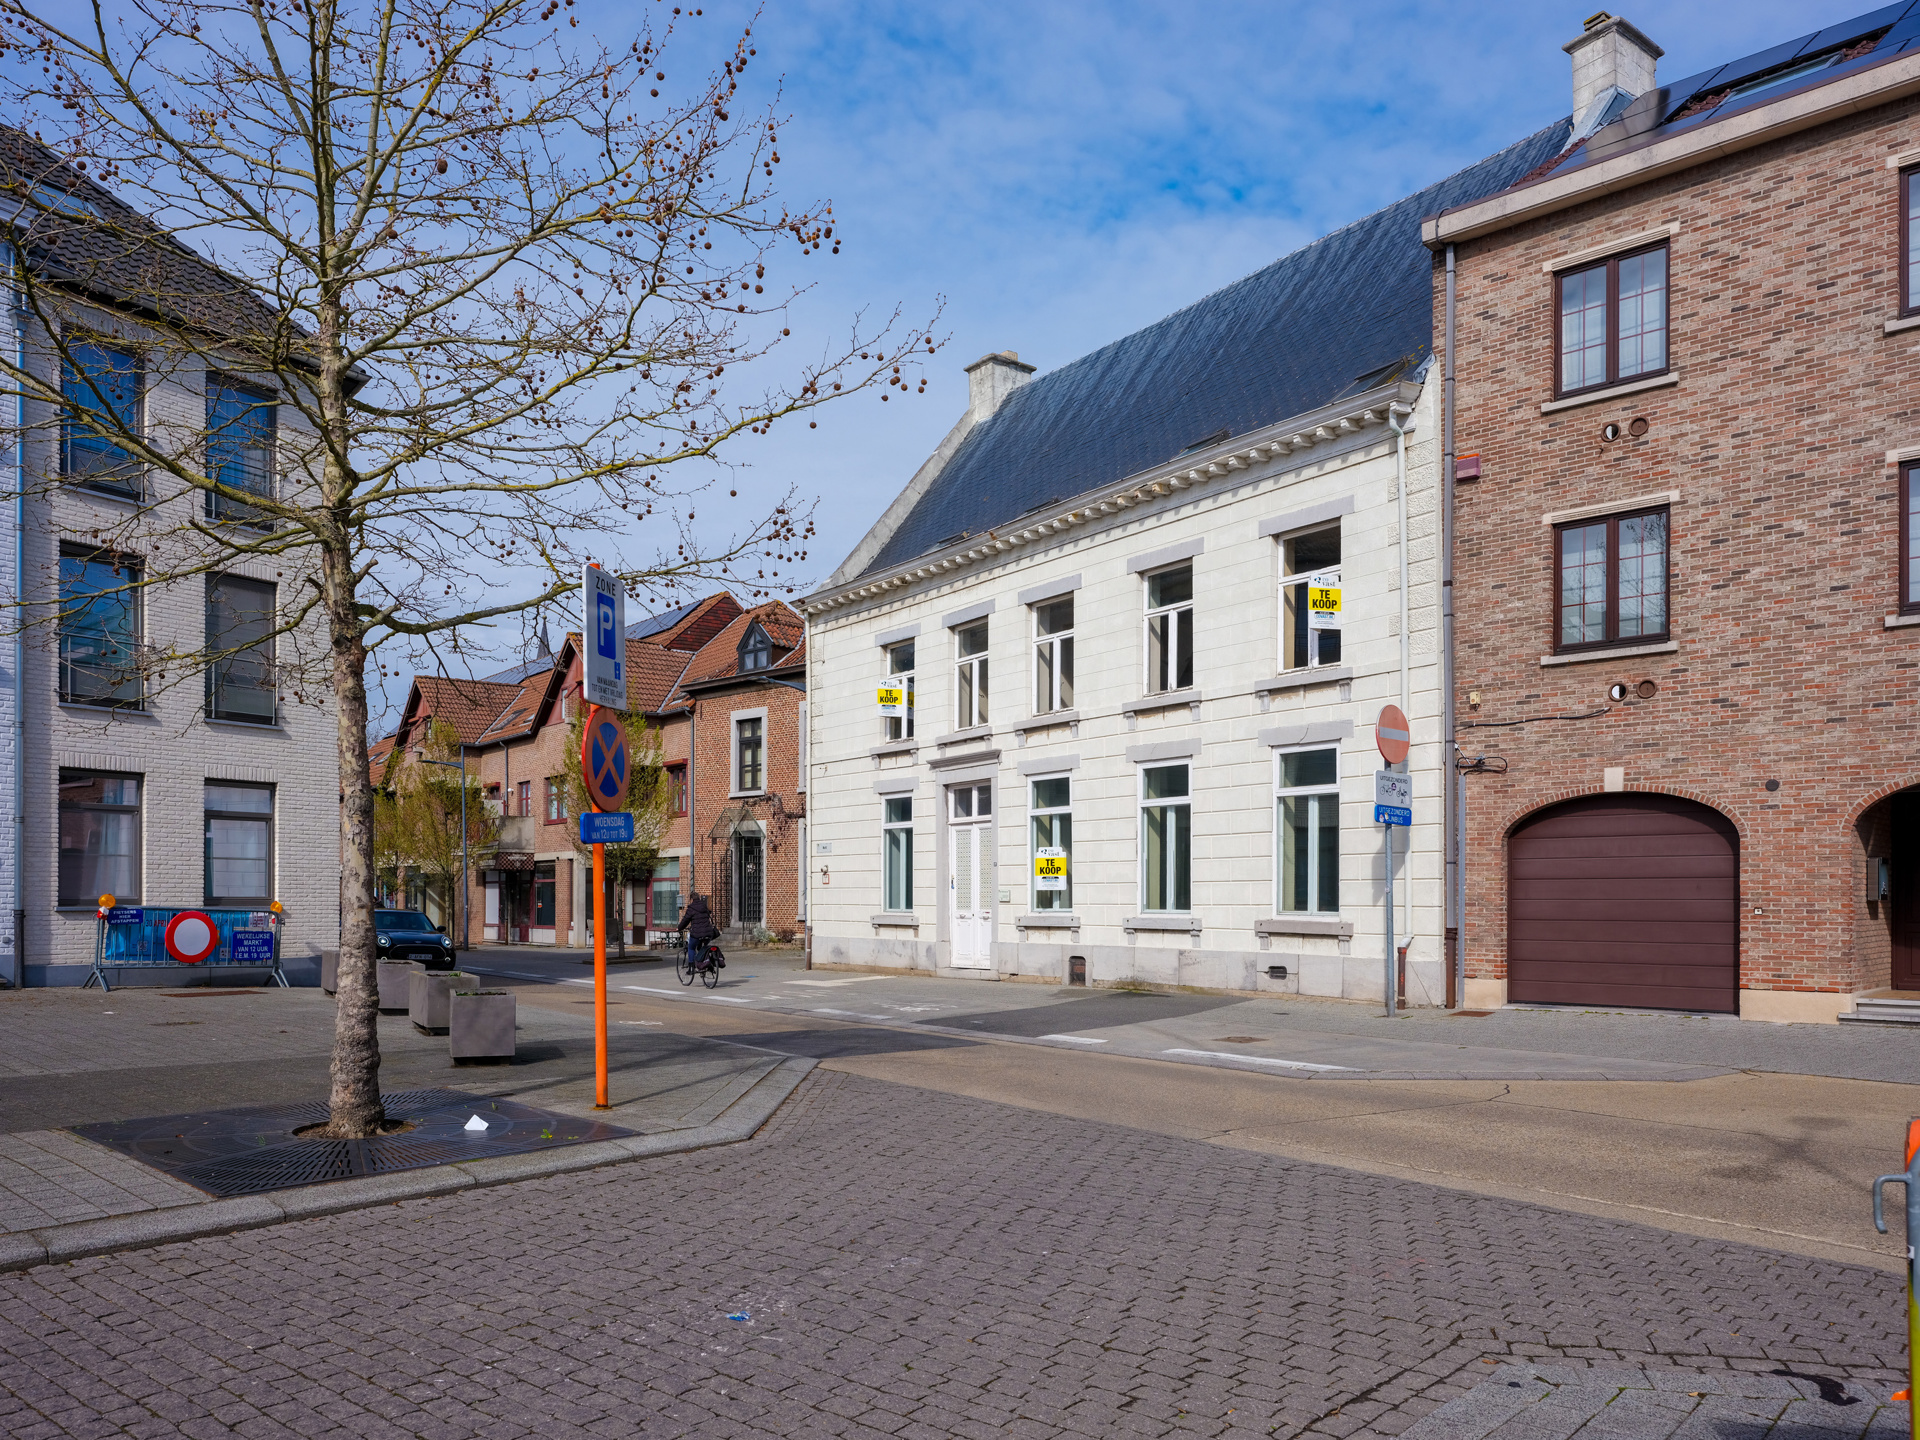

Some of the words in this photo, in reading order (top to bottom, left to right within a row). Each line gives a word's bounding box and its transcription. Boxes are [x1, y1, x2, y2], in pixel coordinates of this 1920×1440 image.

[595, 576, 616, 597] ZONE
[1319, 589, 1330, 599] TE
[1312, 599, 1337, 609] KOOP
[1380, 775, 1408, 784] UITGEZONDERD
[1379, 806, 1410, 816] UITGEZONDERD
[594, 816, 624, 827] WOENSDAG
[592, 831, 600, 839] VAN
[1039, 866, 1061, 874] KOOP
